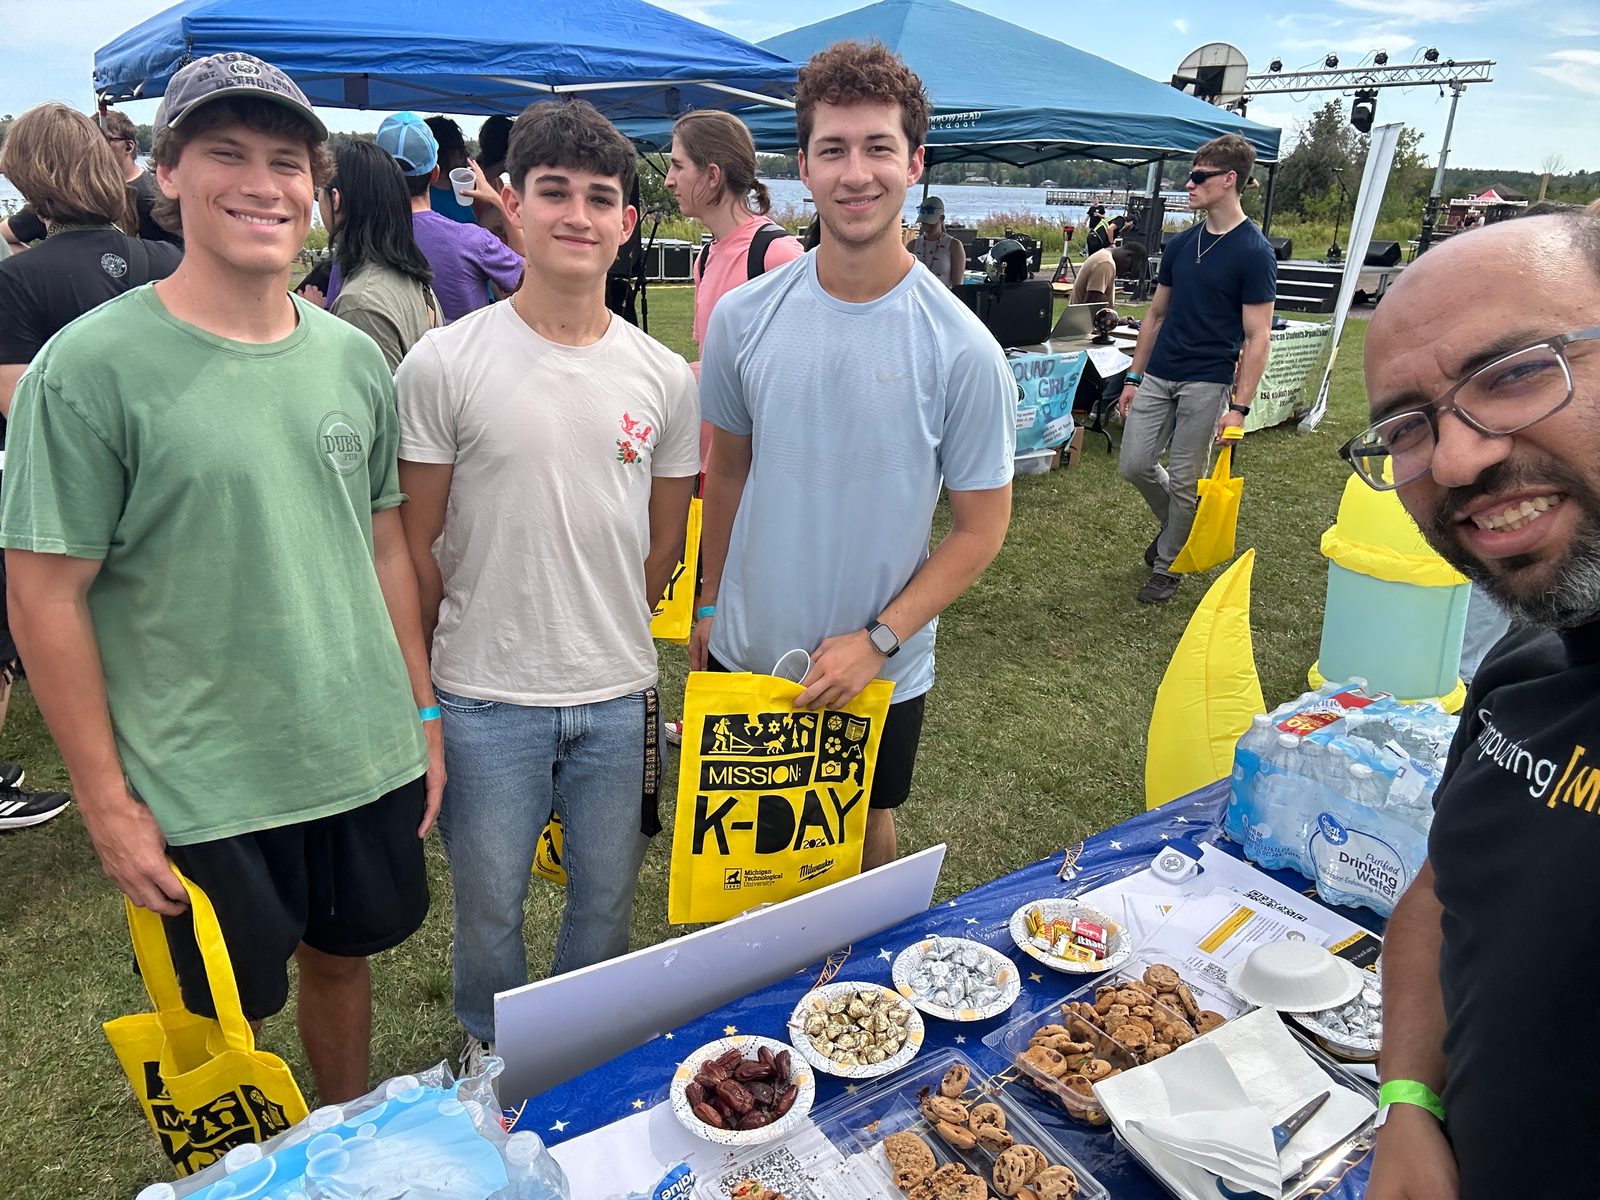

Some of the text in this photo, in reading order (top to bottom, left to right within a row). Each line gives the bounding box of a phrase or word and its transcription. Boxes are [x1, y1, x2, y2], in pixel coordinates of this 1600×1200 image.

[215, 76, 279, 93] DETROIT
[928, 111, 981, 123] RROWHEAD
[930, 121, 976, 130] utdoor
[1011, 359, 1056, 382] OUND
[1038, 372, 1080, 399] GIRLS
[323, 432, 362, 454] DUB'S
[344, 453, 358, 461] PUB
[646, 714, 656, 745] TECH
[1286, 718, 1316, 730] 40
[1478, 708, 1557, 798] Cmputing
[644, 747, 656, 795] HUSKIES
[692, 787, 865, 856] K-DAY
[803, 838, 826, 850] 2026
[744, 868, 772, 878] Michigan
[799, 858, 835, 878] Milwaukee
[1339, 851, 1397, 889] Drinking
[1366, 852, 1400, 877] Purified
[743, 873, 783, 882] Technological
[1356, 868, 1397, 899] Water
